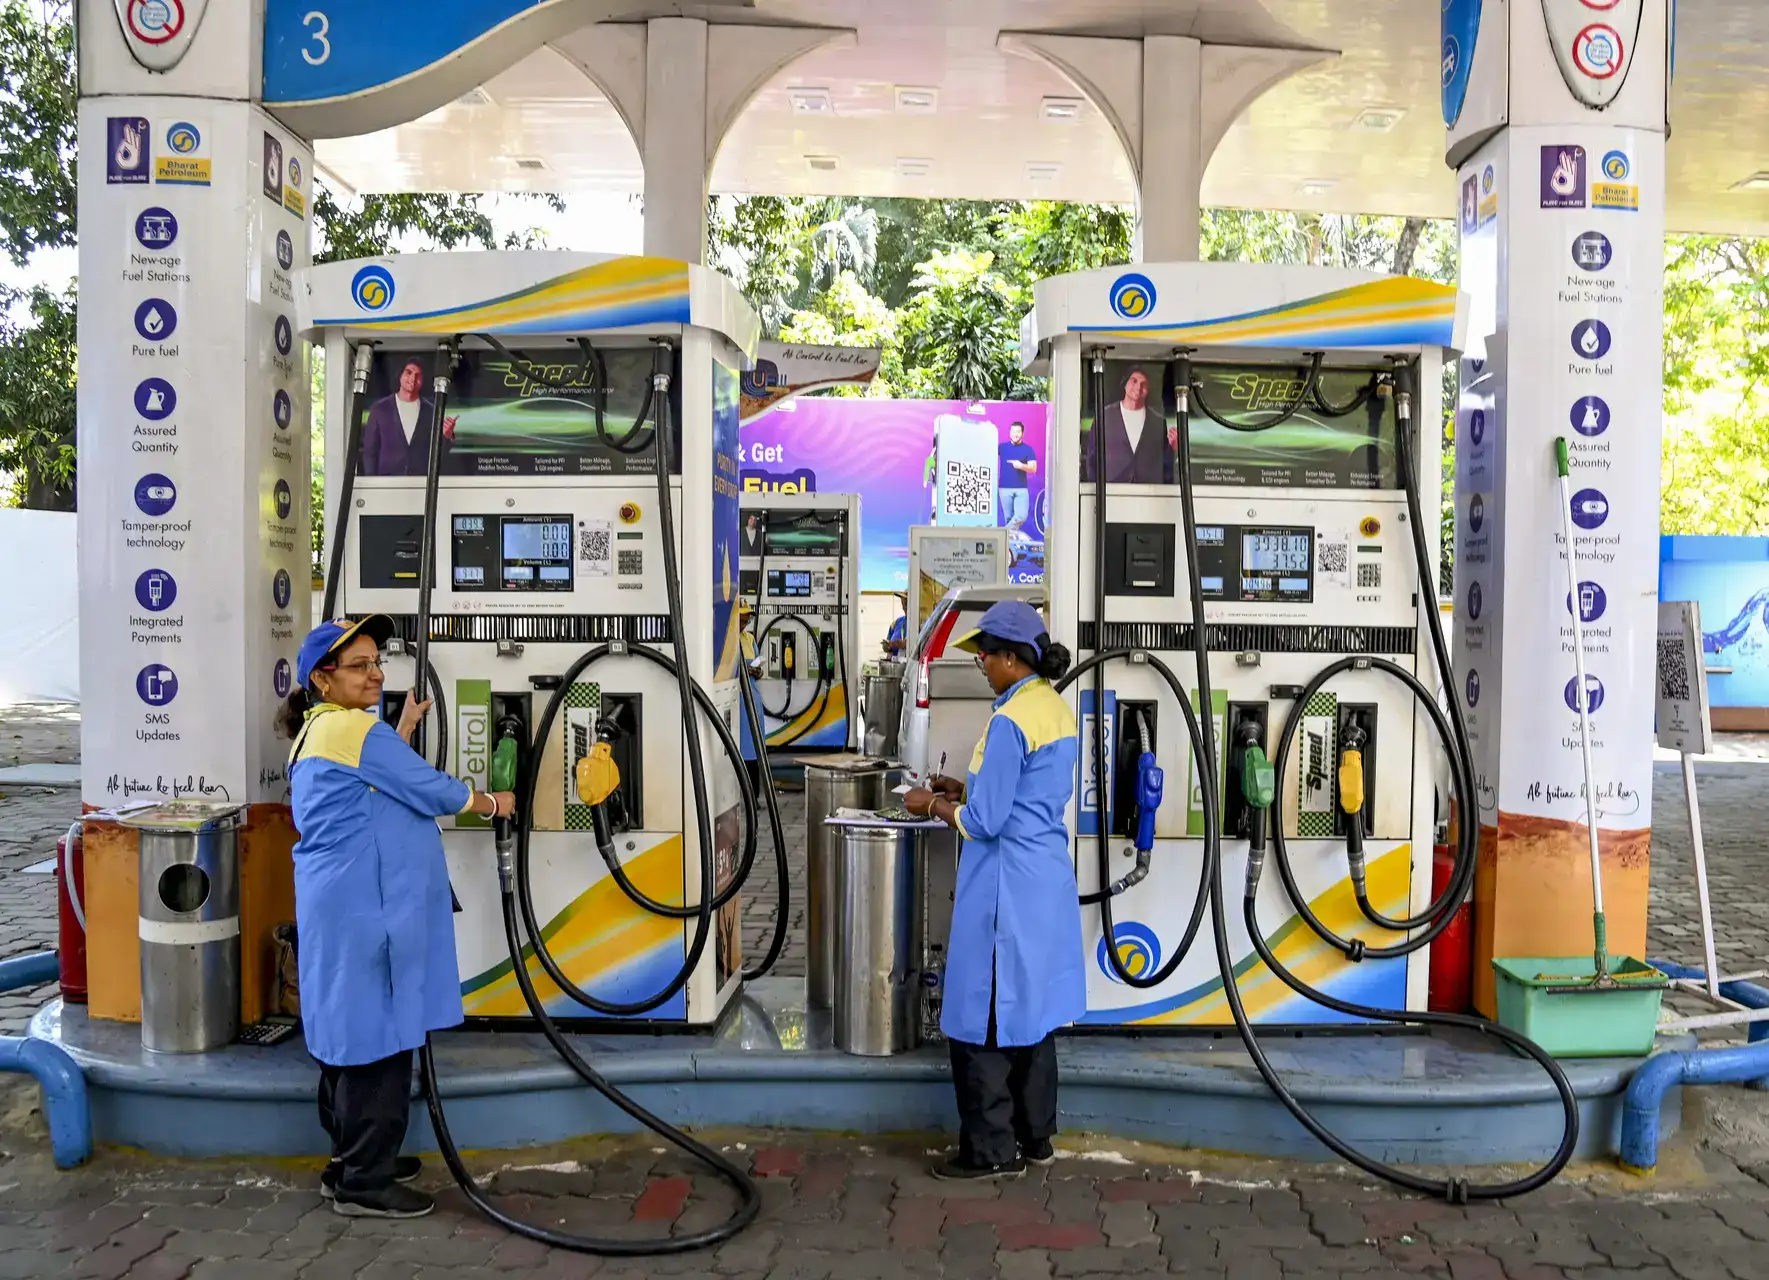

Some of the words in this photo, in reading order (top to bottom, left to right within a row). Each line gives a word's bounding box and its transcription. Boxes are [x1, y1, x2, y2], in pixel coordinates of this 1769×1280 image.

[301, 10, 331, 66] 3
[168, 160, 199, 170] Bharat
[160, 168, 207, 178] Petroleum
[1602, 186, 1629, 196] Bharat
[1596, 194, 1635, 204] Petroleum
[130, 254, 181, 268] New-age
[122, 270, 144, 282] Fuel
[147, 270, 190, 283] Stations
[1568, 276, 1615, 289] New-age
[1558, 290, 1580, 302] Fuel
[1584, 292, 1623, 304] Stations
[132, 346, 156, 356] Pure
[159, 346, 179, 356] fuel
[782, 349, 794, 359] Ab
[796, 350, 822, 360] Control
[1568, 364, 1591, 375] Pure
[1595, 364, 1613, 376] fuel
[134, 425, 177, 436] Assured
[132, 442, 179, 455] Quantity
[752, 442, 784, 463] Get
[1569, 441, 1610, 452] Assured
[1568, 456, 1612, 470] Quantity
[122, 520, 192, 533] Tamper-proof
[126, 536, 186, 550] technology
[1254, 536, 1307, 552] 3938.10
[1554, 532, 1620, 548] Taper-proof
[1273, 554, 1306, 570] 37.52
[1560, 548, 1616, 563] tehnology
[129, 615, 184, 629] Integrated
[132, 632, 182, 646] Payments
[1560, 626, 1612, 639] Intgrated
[1562, 642, 1610, 653] Paments
[145, 714, 170, 724] SMS
[136, 730, 180, 744] Updates
[462, 712, 487, 792] Petrol
[106, 774, 119, 794] Ab
[124, 776, 152, 797] future
[174, 776, 195, 798] feel
[1528, 782, 1541, 802] Ab
[1546, 784, 1576, 804] future
